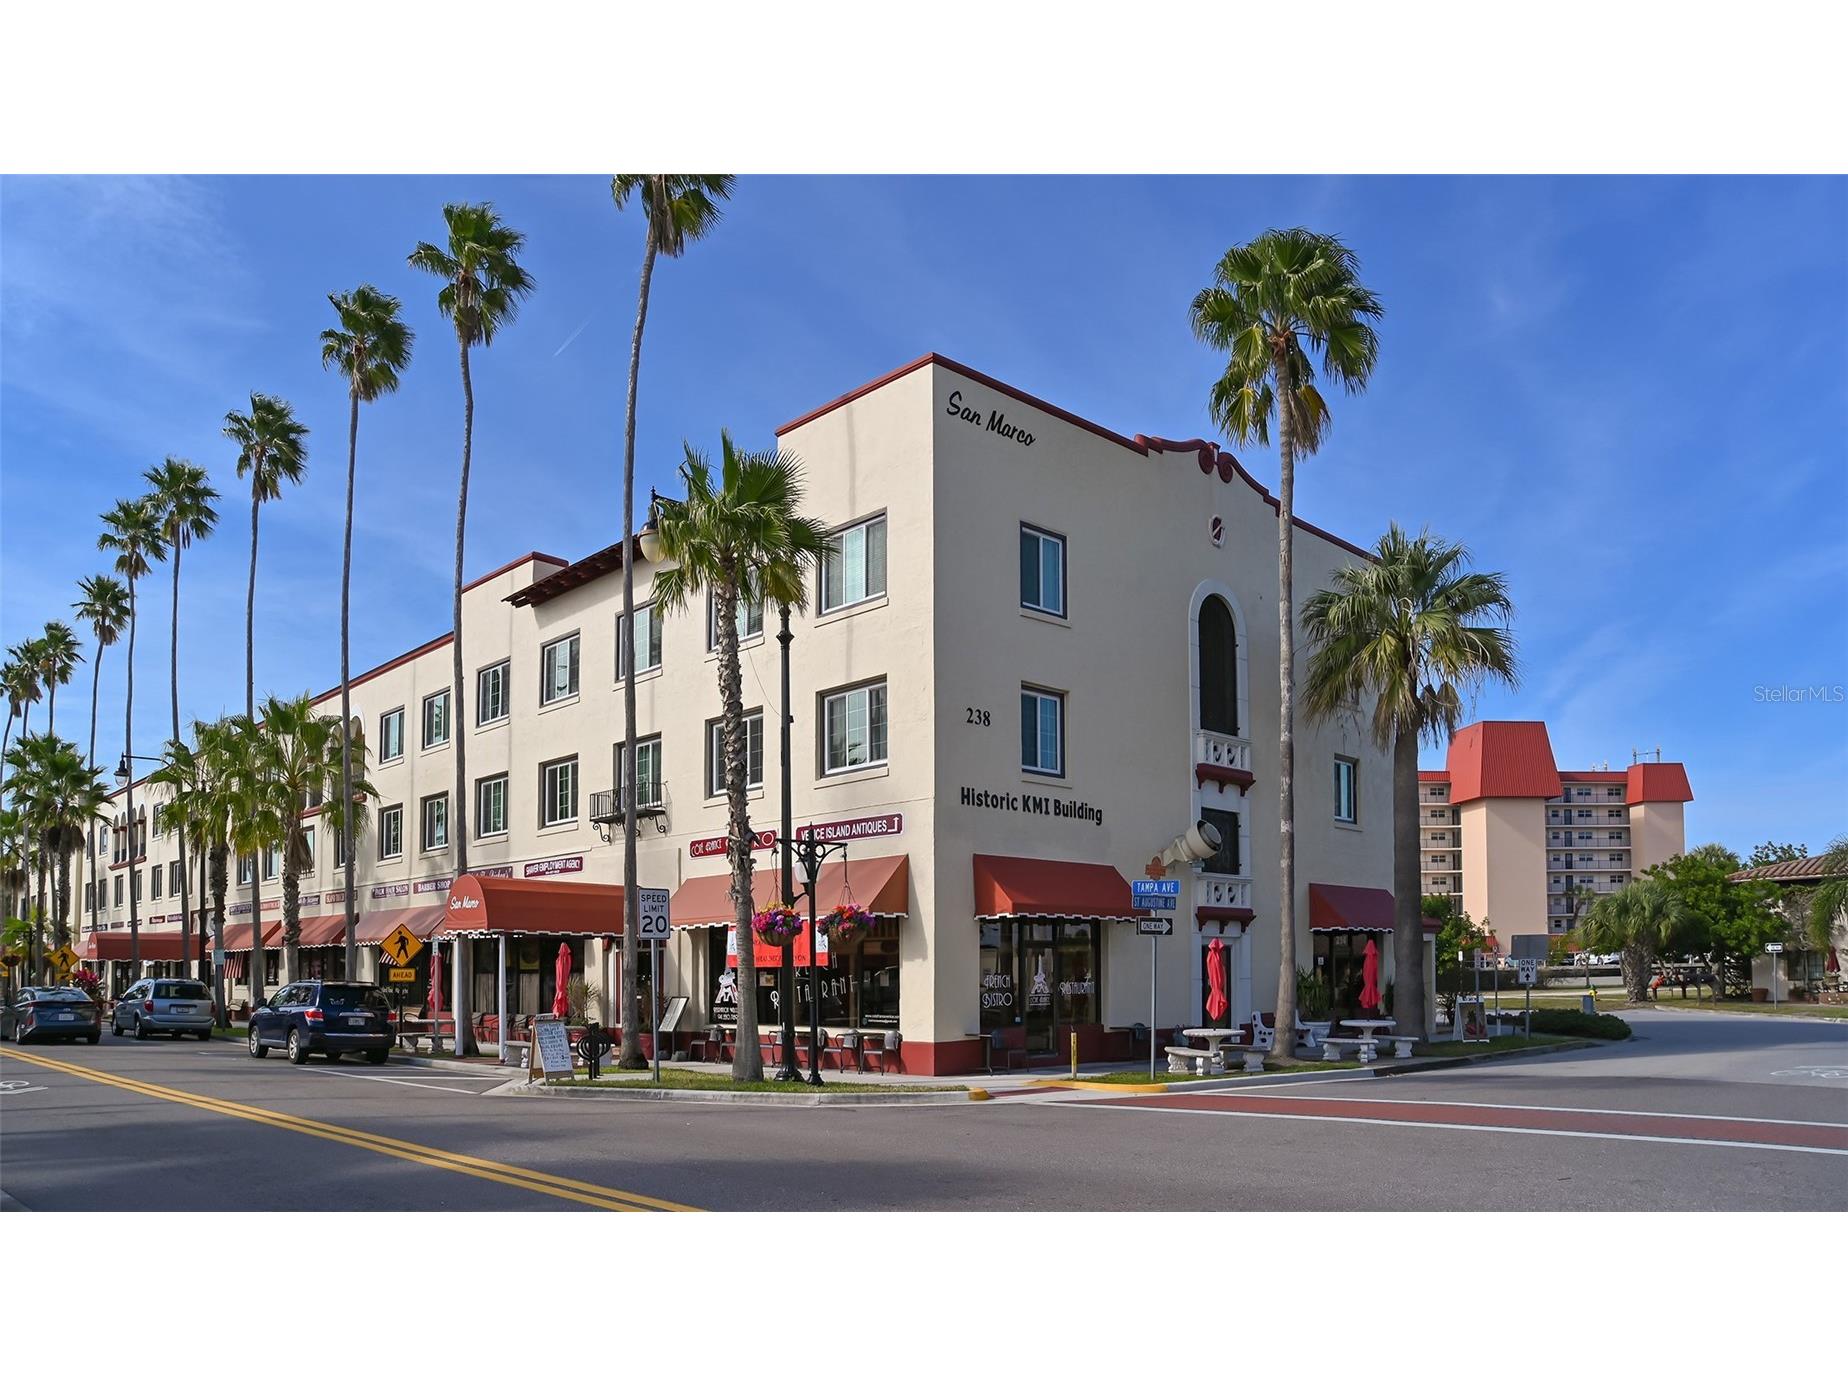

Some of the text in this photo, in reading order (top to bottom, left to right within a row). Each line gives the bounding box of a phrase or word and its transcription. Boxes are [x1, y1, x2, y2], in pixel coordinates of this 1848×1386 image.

[946, 390, 1036, 446] San Marco
[966, 707, 991, 727] 238
[961, 786, 1103, 826] Historic KMI Building
[801, 820, 887, 842] VEICE ISLAND ANTIQUES
[539, 859, 566, 872] EMPLOYMENT
[566, 858, 580, 869] AGENCY
[418, 880, 451, 892] BARBER SHOP
[1137, 882, 1175, 893] TAMPA AVE
[450, 896, 479, 909] San Marco
[641, 894, 667, 902] SPEED
[1134, 897, 1176, 910] ST AUGUSTINE AVE
[642, 915, 667, 933] 20
[1143, 922, 1164, 930] ONE WAY
[984, 974, 1010, 989] FRENCH
[982, 992, 1013, 1009] BISTRO
